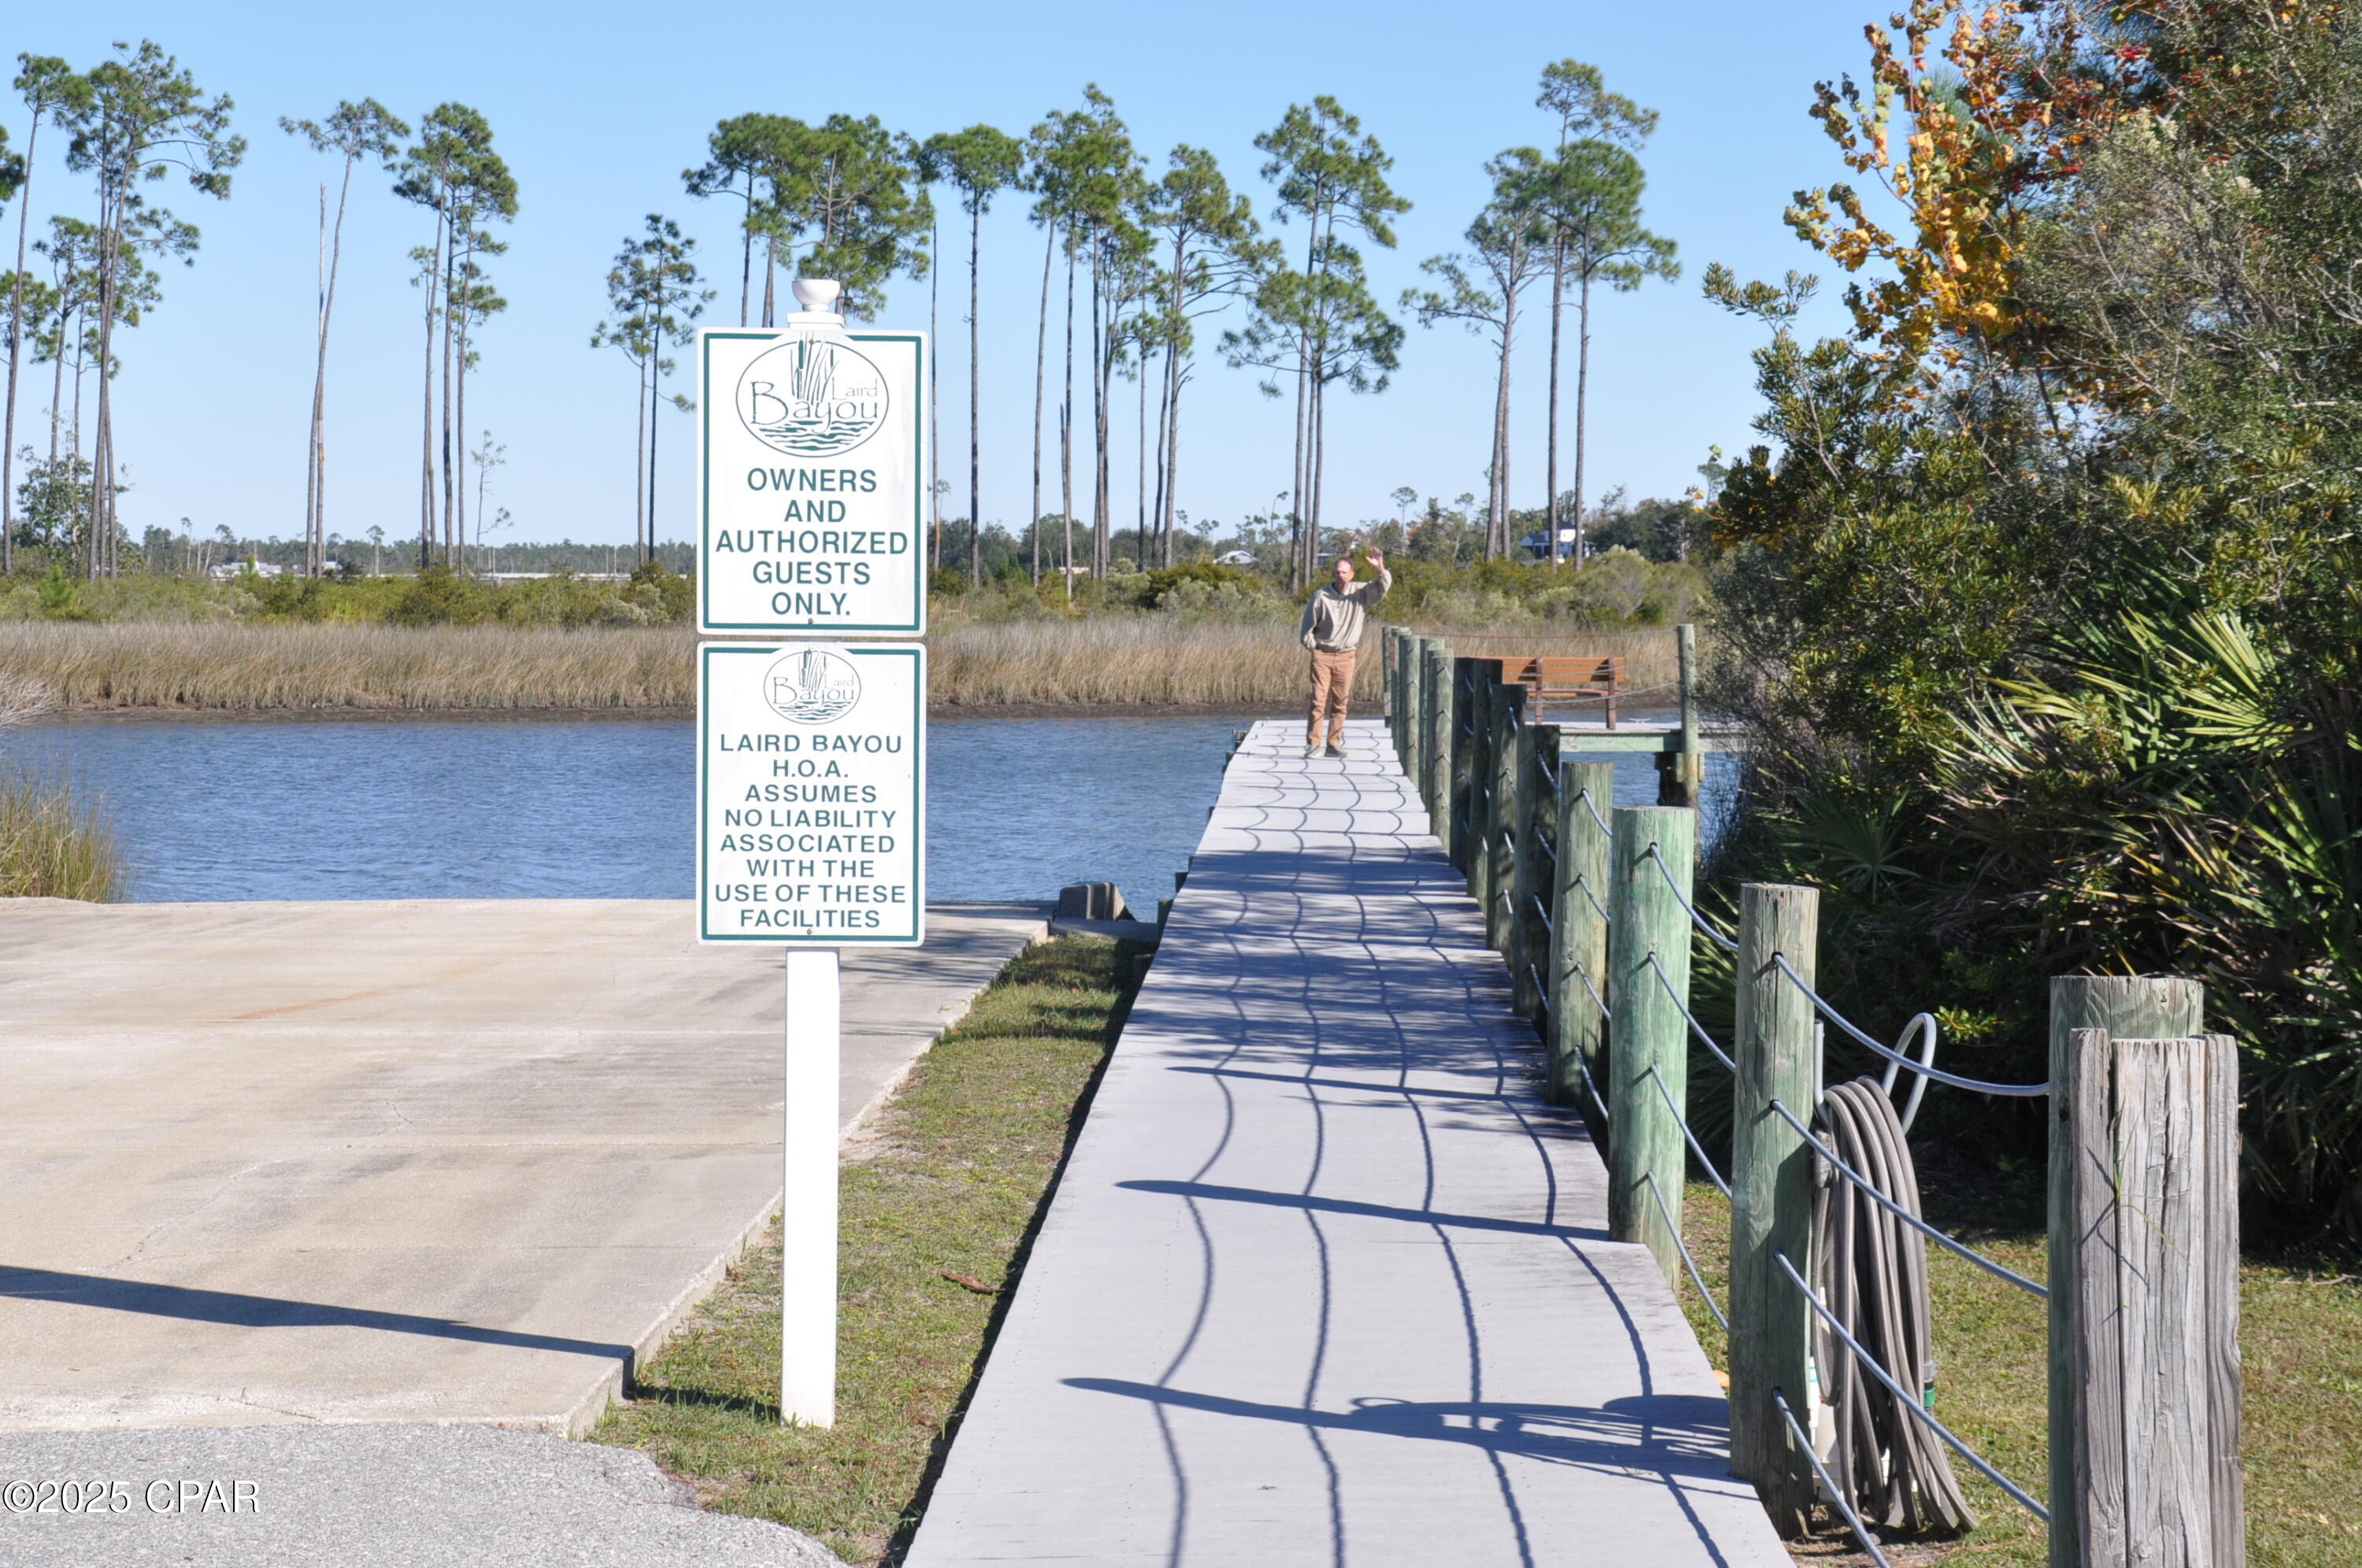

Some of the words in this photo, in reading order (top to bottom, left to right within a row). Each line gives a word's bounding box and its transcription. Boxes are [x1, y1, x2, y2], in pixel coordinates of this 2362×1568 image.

[831, 377, 878, 400] Laird
[750, 381, 878, 434] Bayou
[747, 468, 877, 492] OWNERS
[784, 500, 846, 523] AND
[716, 530, 908, 554] AUTHORIZED
[753, 561, 871, 585] GUESTS
[772, 592, 850, 616] ONLY.
[824, 674, 853, 688] Laird
[773, 677, 853, 708] Bayou
[720, 734, 800, 753] LAIRD
[813, 735, 901, 753] BAYOU
[773, 760, 849, 778] H.O.A.
[745, 785, 877, 803] ASSUMES
[725, 809, 762, 827] NO
[771, 810, 896, 827] LIABILITY
[720, 834, 894, 852] ASSOCIATED
[746, 859, 814, 877] WITH
[823, 860, 874, 878] THE
[715, 885, 767, 902] USE
[776, 885, 810, 902] OF
[818, 885, 905, 903] THESE
[740, 909, 880, 927] FACILITIES
